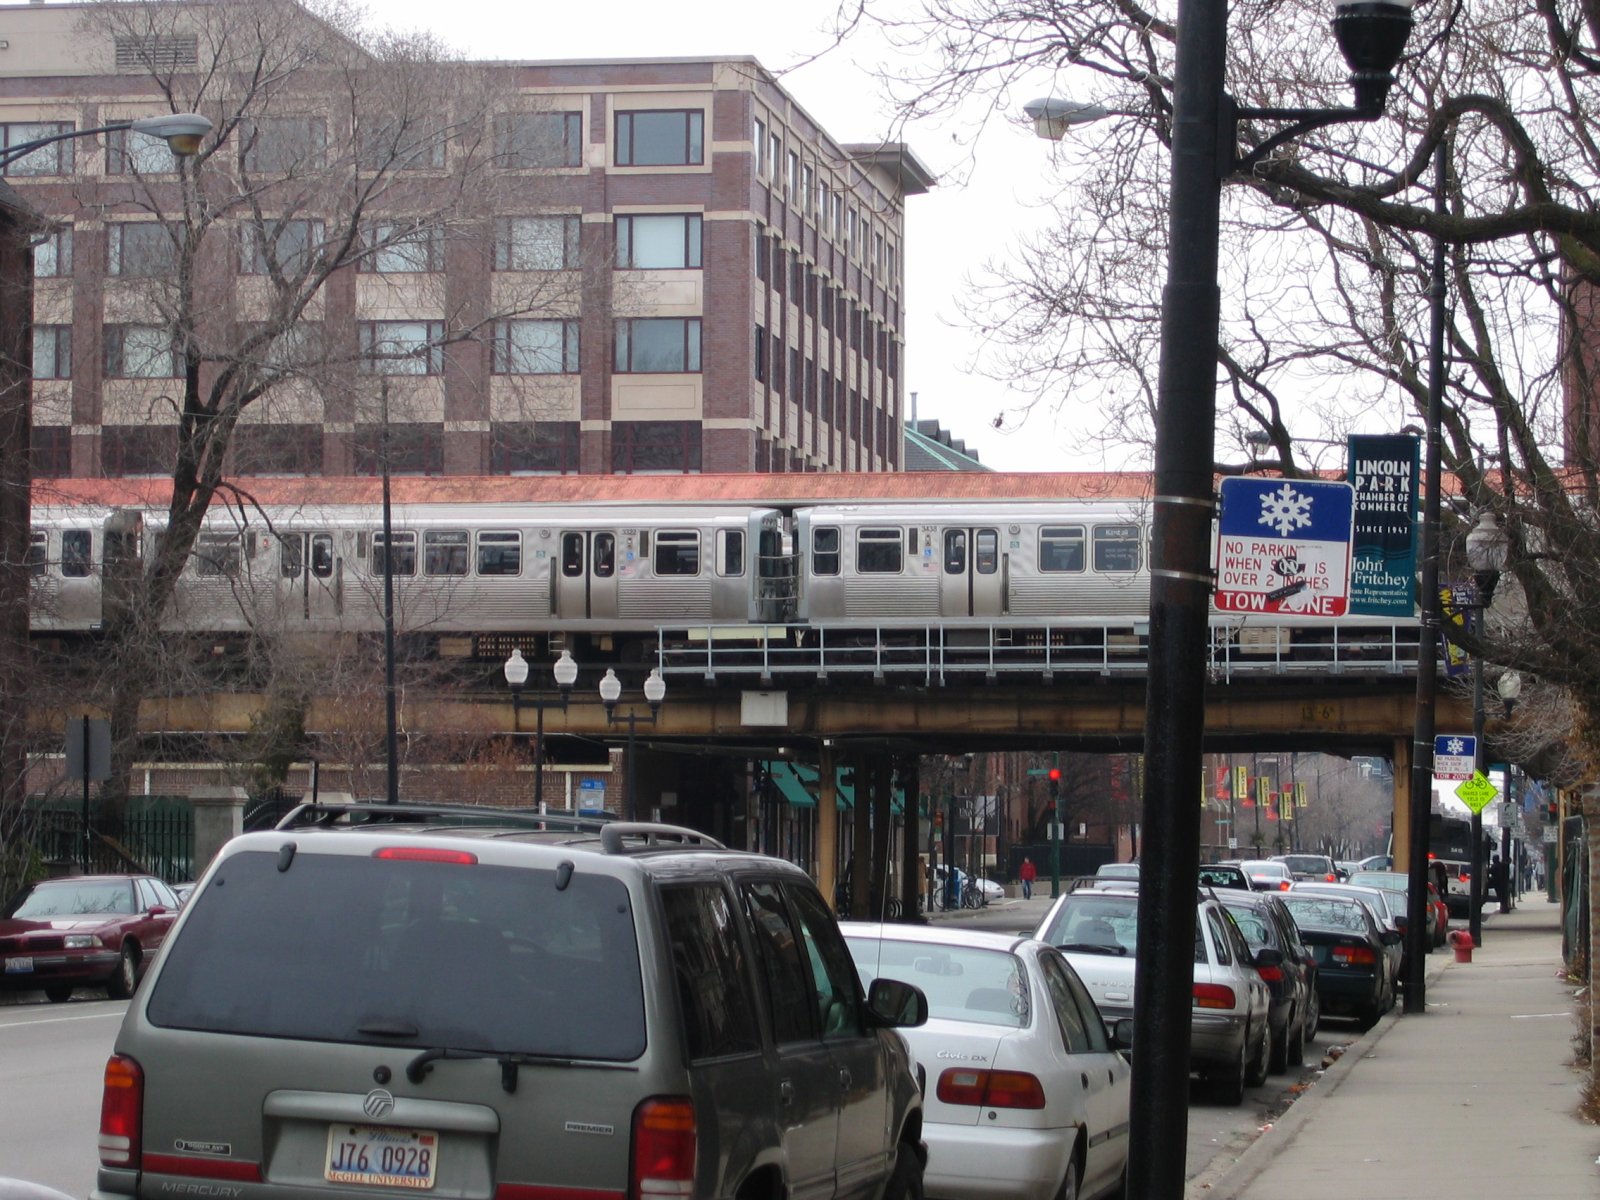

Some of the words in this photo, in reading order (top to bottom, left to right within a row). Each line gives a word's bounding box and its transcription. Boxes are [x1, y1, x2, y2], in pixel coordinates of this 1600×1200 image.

[1355, 459, 1411, 476] LINCOLN
[1354, 492, 1395, 502] CHAMBER
[1397, 493, 1409, 502] OF
[1354, 502, 1408, 512] COMMERCE
[1355, 525, 1383, 533] SINCE
[1225, 541, 1243, 554] NO
[1251, 543, 1297, 557] PARKIN
[1225, 556, 1262, 570] WHEN
[1315, 562, 1327, 574] IS
[1352, 556, 1384, 572] John
[1224, 571, 1258, 586] OVER
[1266, 574, 1275, 587] 2
[1354, 570, 1410, 589] Fritchey
[1364, 587, 1409, 596] Representative
[1222, 592, 1266, 610] TOW
[936, 1050, 968, 1060] Civic
[566, 1123, 612, 1134] PREMIER
[331, 1142, 368, 1172] J76
[381, 1146, 431, 1176] 0928
[327, 1171, 364, 1181] McGILL
[368, 1174, 430, 1187] UNIVERSITY
[161, 1182, 243, 1197] MERCURY
